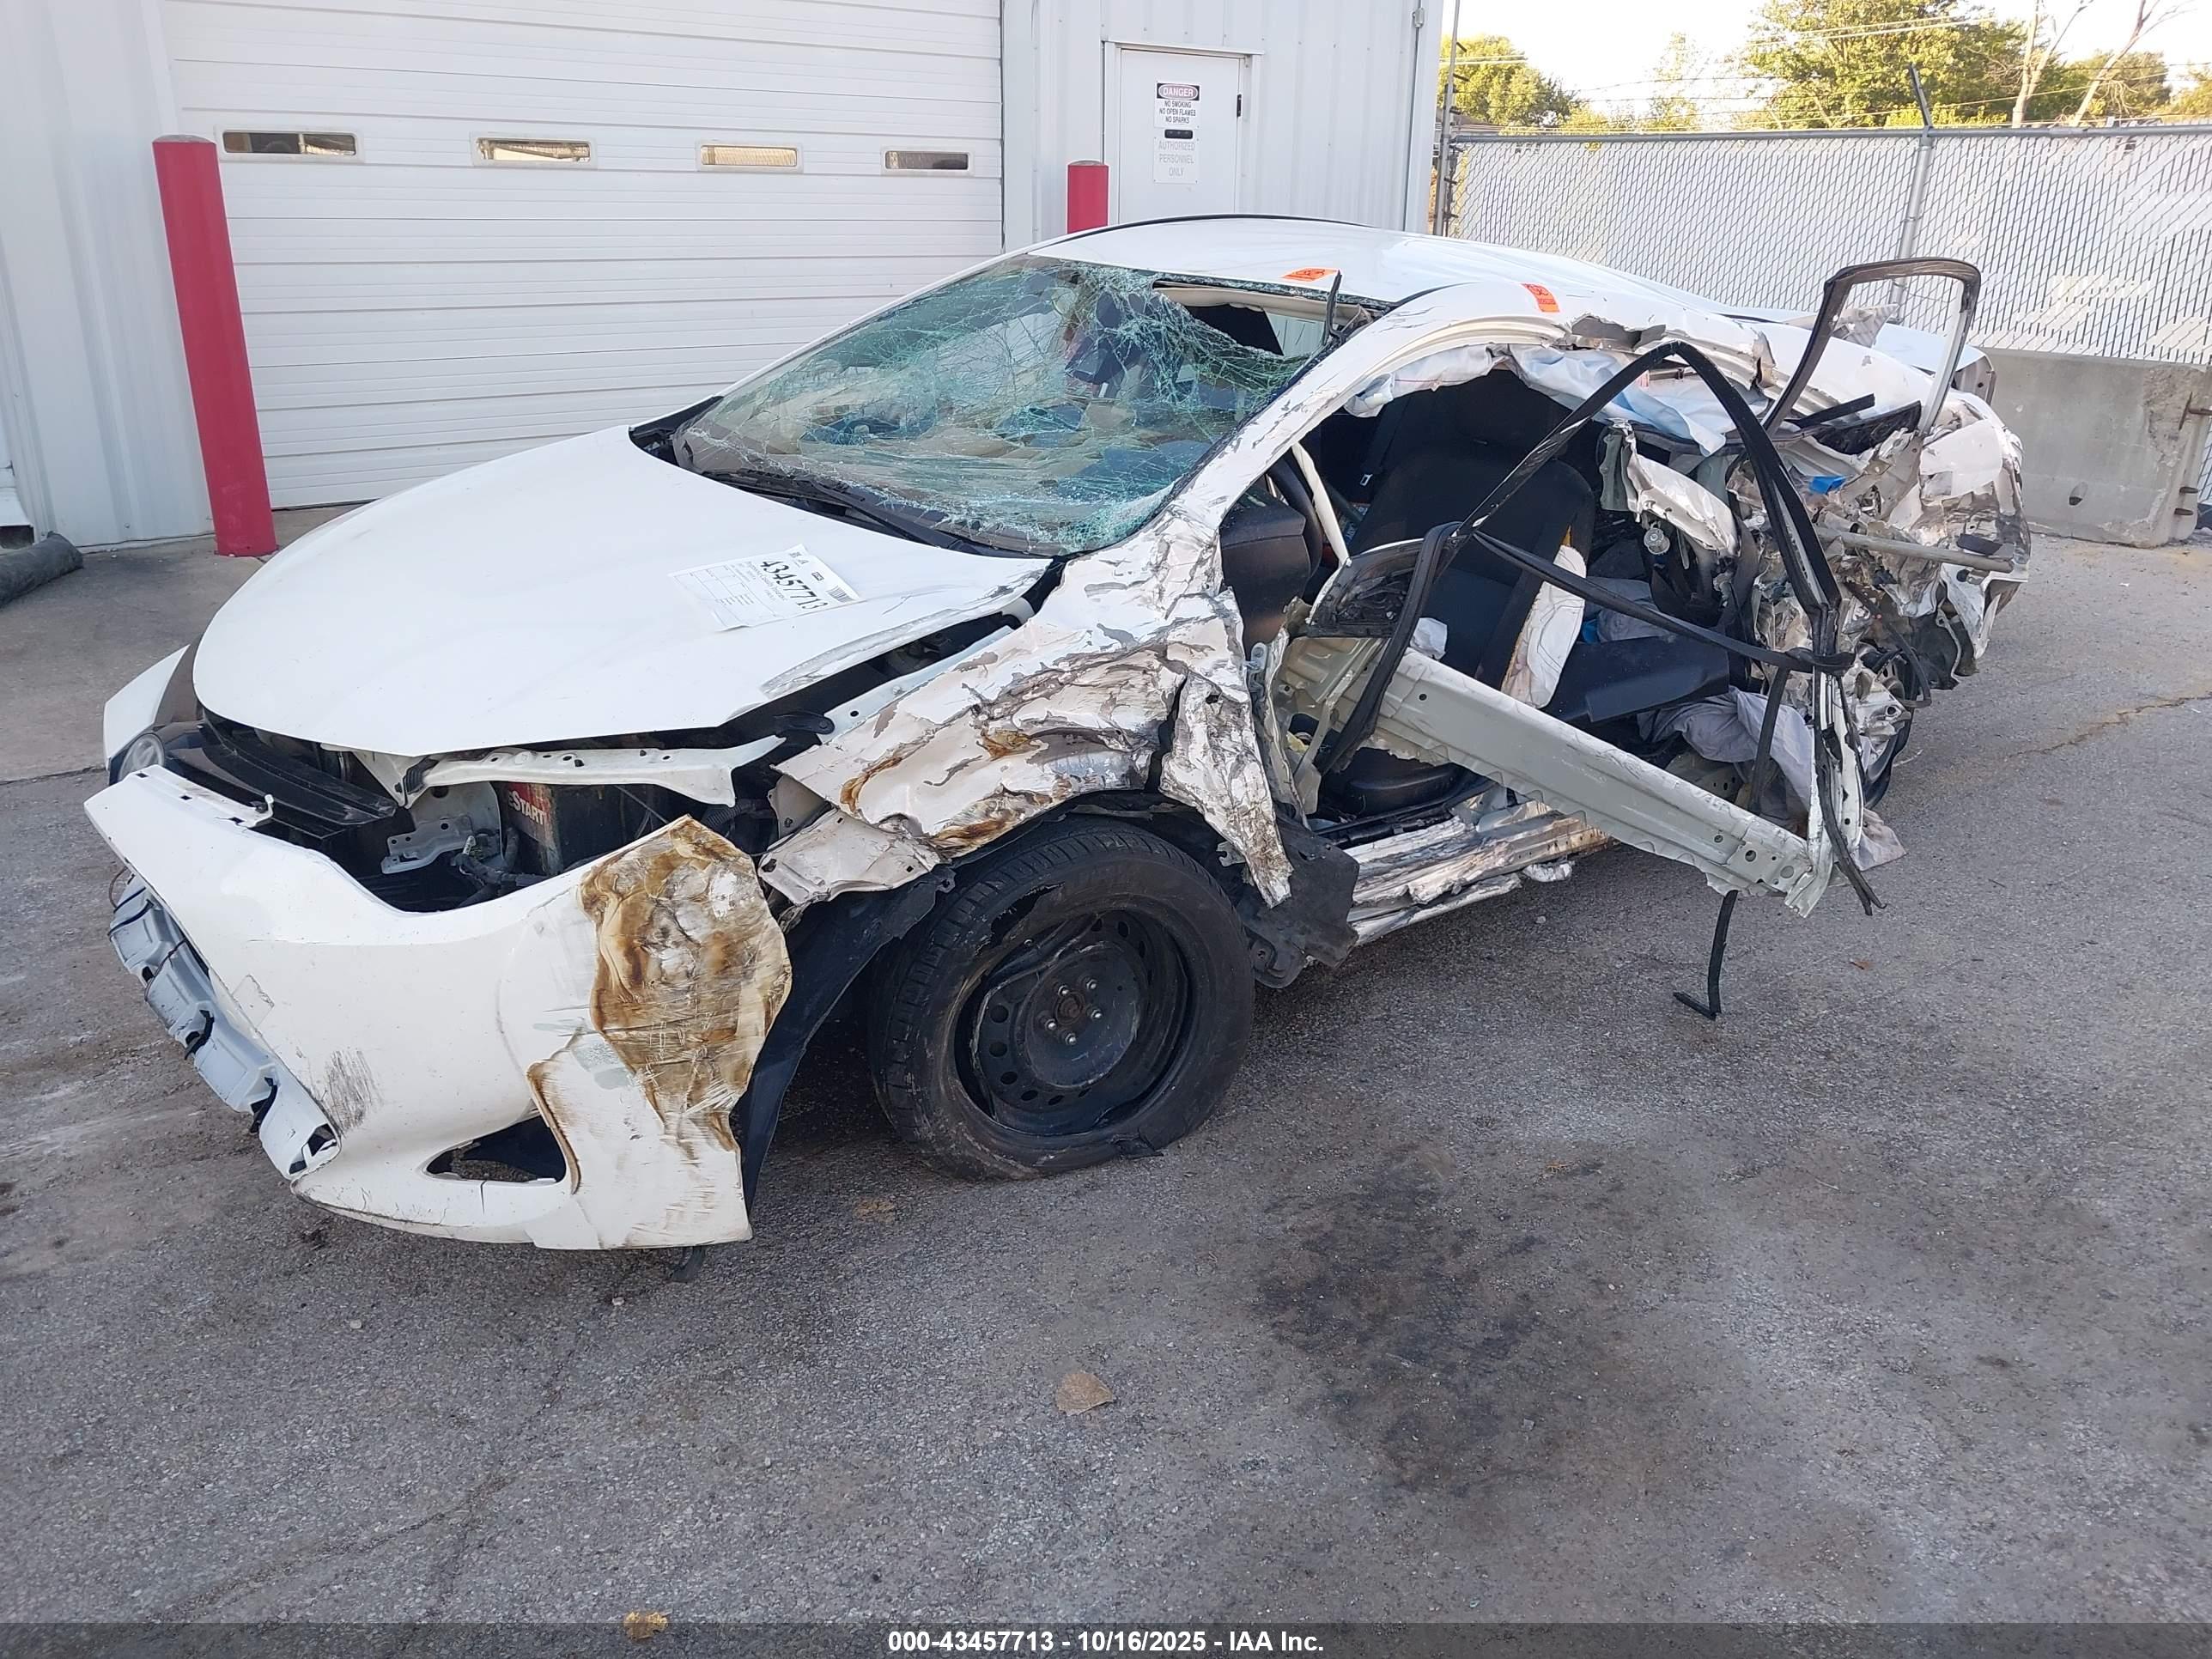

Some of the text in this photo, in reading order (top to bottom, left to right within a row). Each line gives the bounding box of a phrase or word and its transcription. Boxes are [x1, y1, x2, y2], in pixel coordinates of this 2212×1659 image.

[1163, 88, 1194, 97] DANGER
[1158, 141, 1195, 151] AUTHORIZED
[1159, 154, 1194, 164] PERSONNEL
[1169, 167, 1184, 177] ONLY
[760, 561, 829, 610] 43457713
